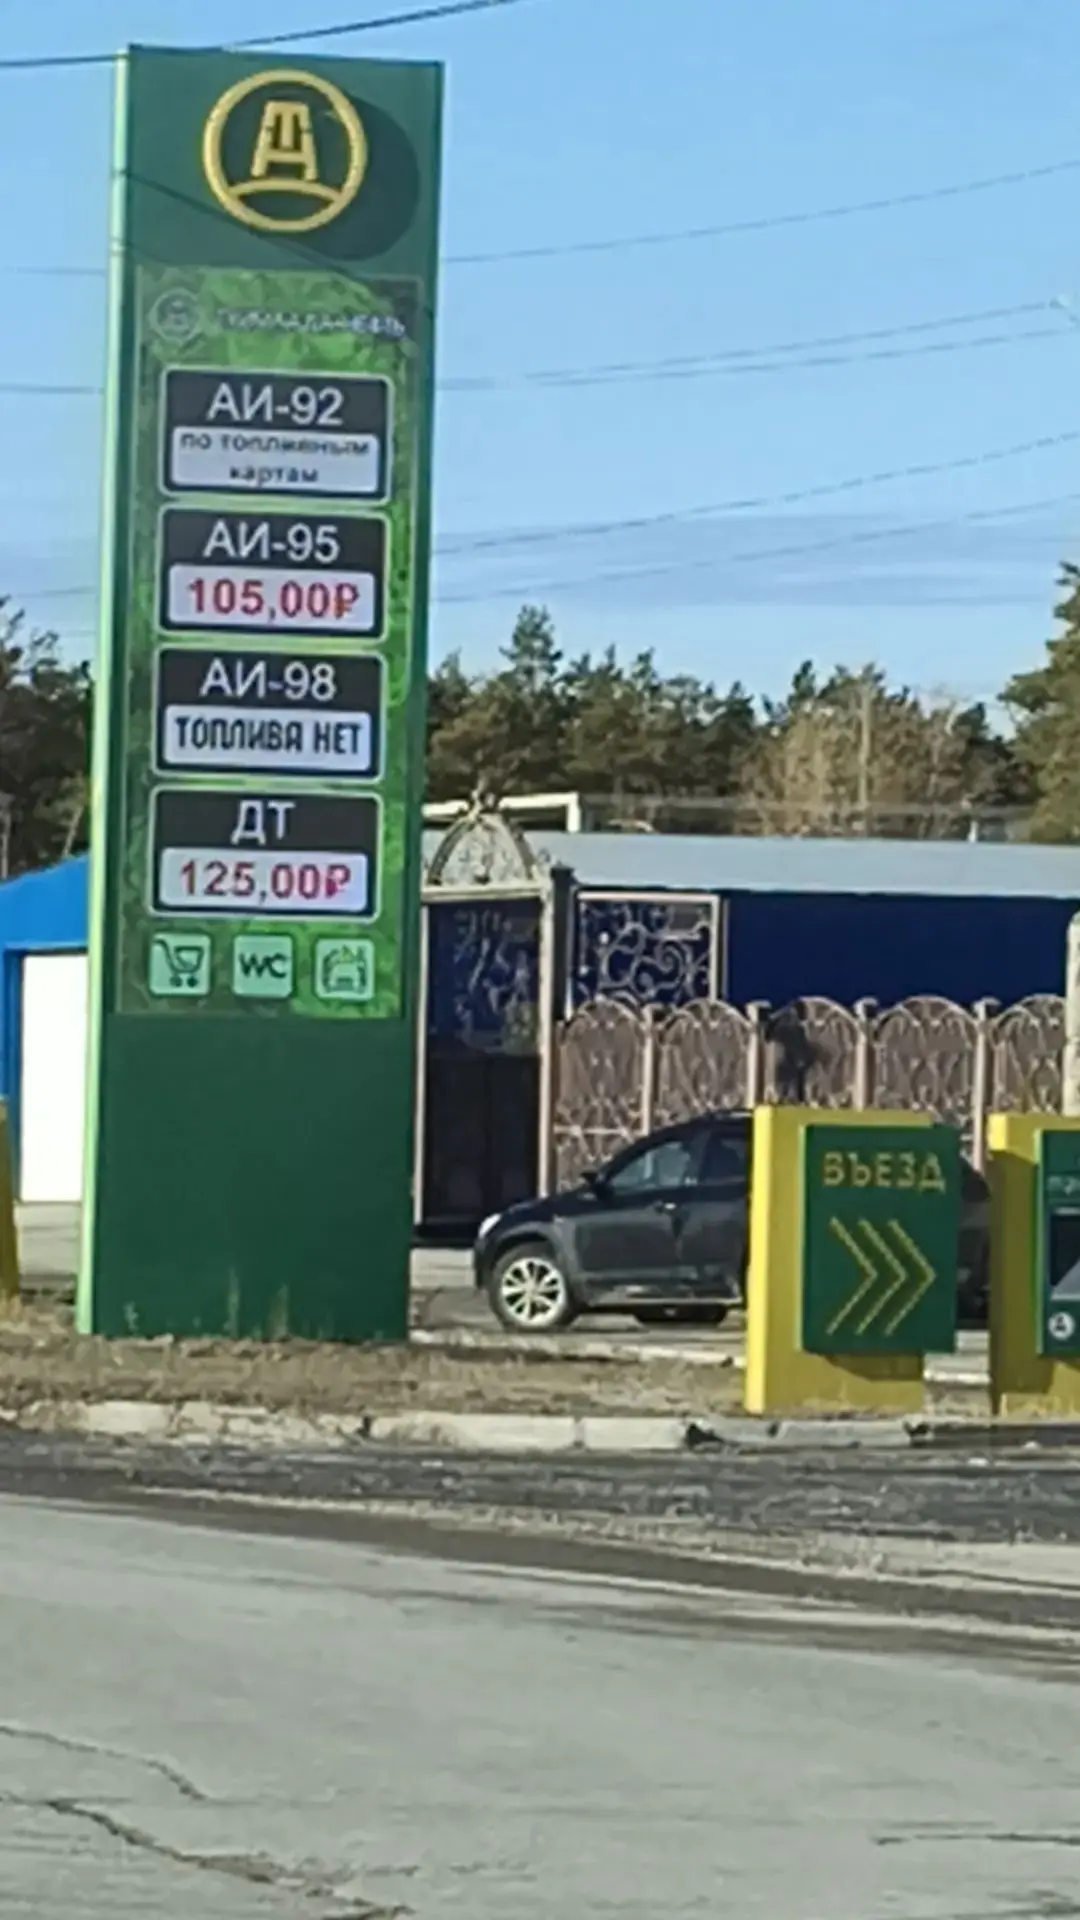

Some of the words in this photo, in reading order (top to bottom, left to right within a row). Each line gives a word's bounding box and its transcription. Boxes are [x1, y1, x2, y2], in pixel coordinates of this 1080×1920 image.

[206, 382, 344, 426] АИ-92
[180, 433, 212, 449] по
[229, 465, 319, 487] картам
[202, 519, 341, 564] АИ-95
[199, 657, 337, 702] АИ-98
[175, 717, 303, 753] ТОПЛИВА
[313, 721, 362, 755] НЕТ
[230, 800, 296, 845] ДТ
[238, 953, 289, 979] WC
[823, 1151, 946, 1193] ВЪЕЗД
